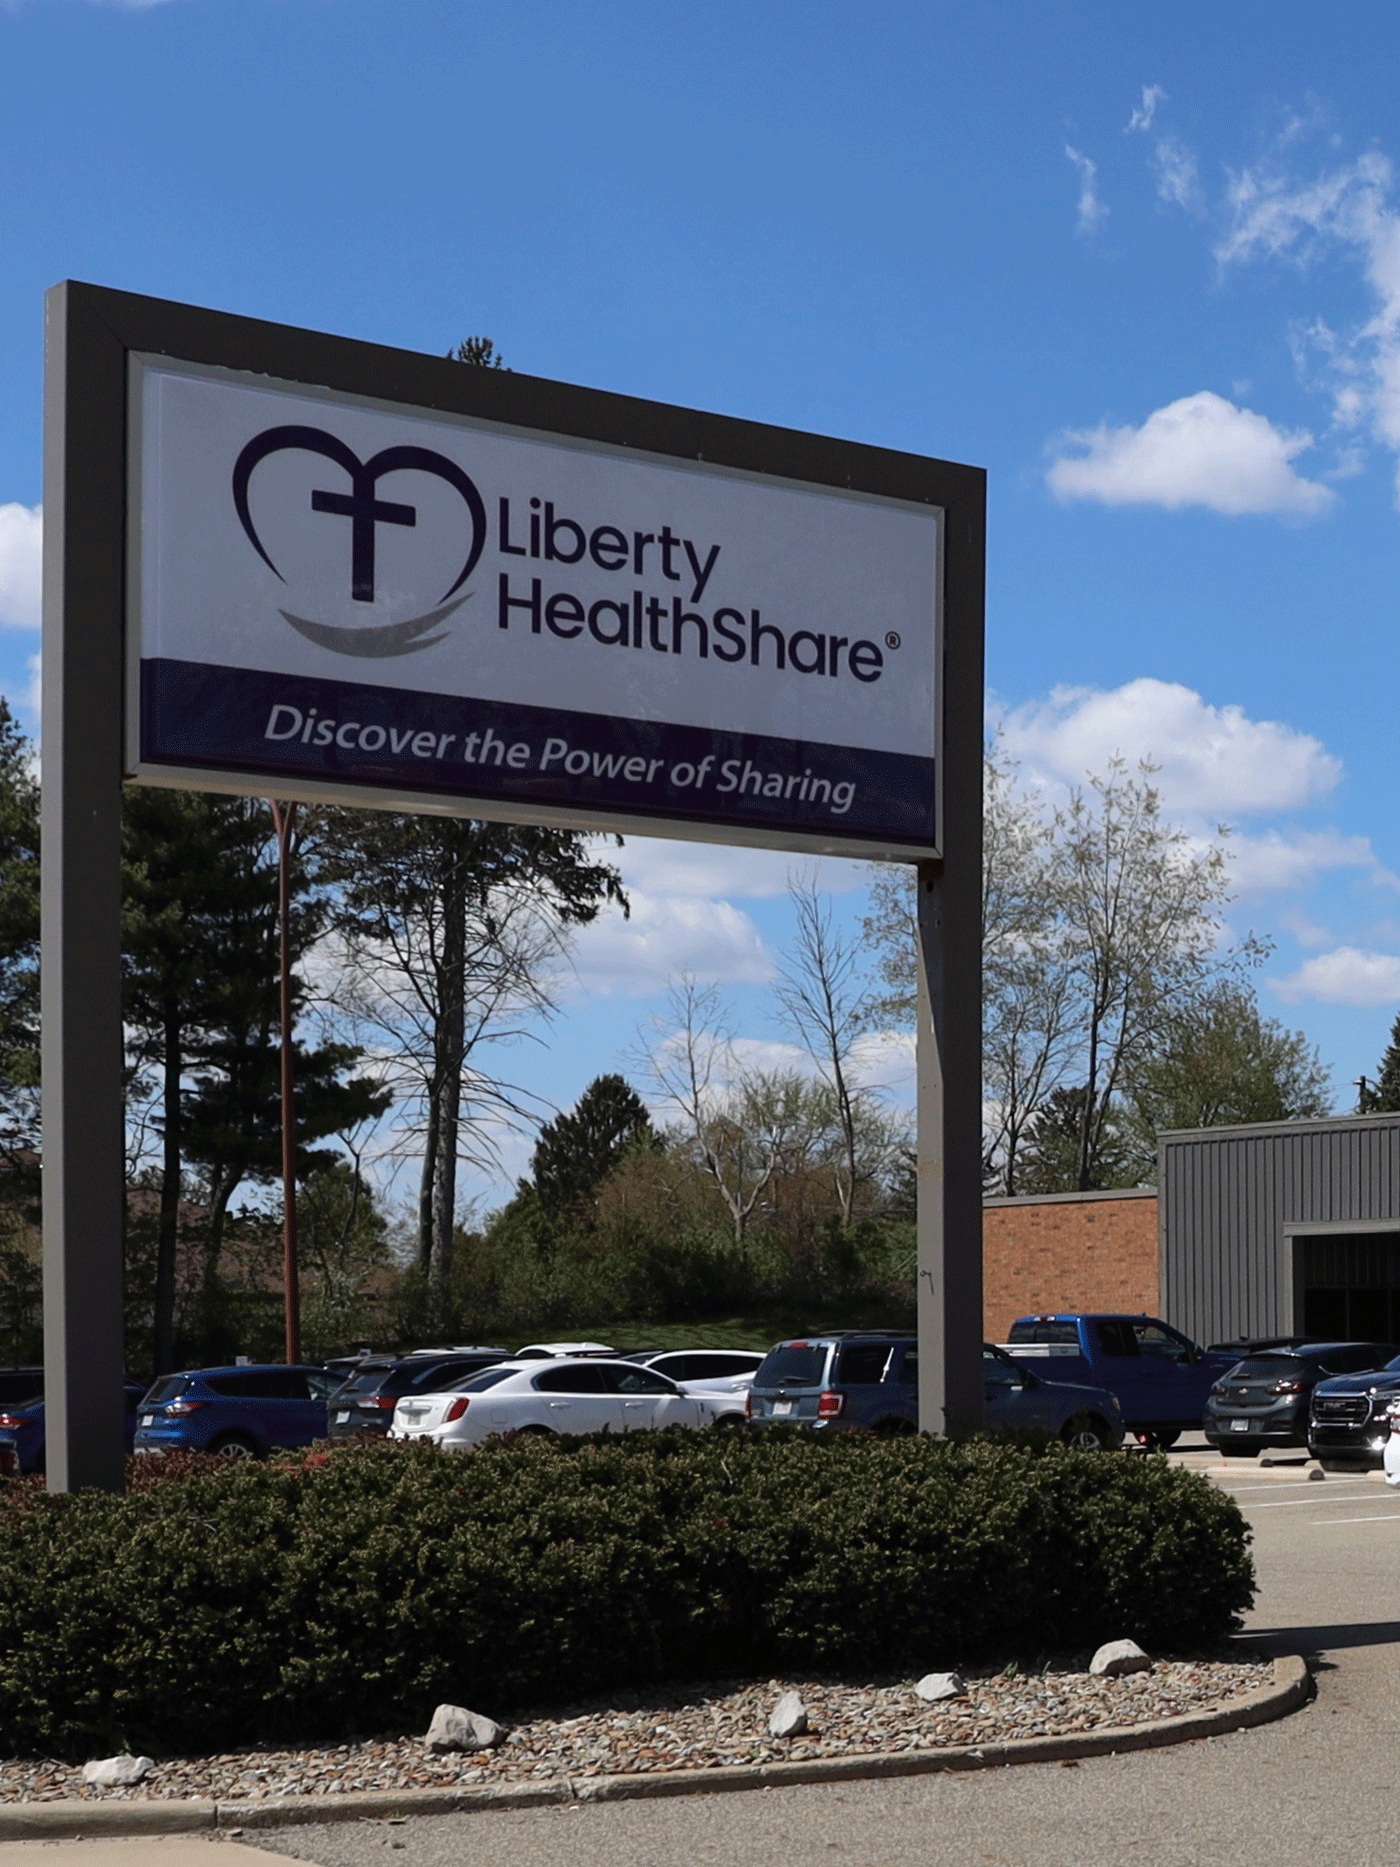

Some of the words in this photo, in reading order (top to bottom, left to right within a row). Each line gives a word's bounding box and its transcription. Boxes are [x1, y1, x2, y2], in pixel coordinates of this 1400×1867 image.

[499, 496, 721, 604] Liberty
[264, 704, 456, 760] Discover
[464, 728, 531, 768] the
[538, 738, 664, 784] Power
[670, 755, 716, 789] of
[716, 759, 857, 815] Sharing
